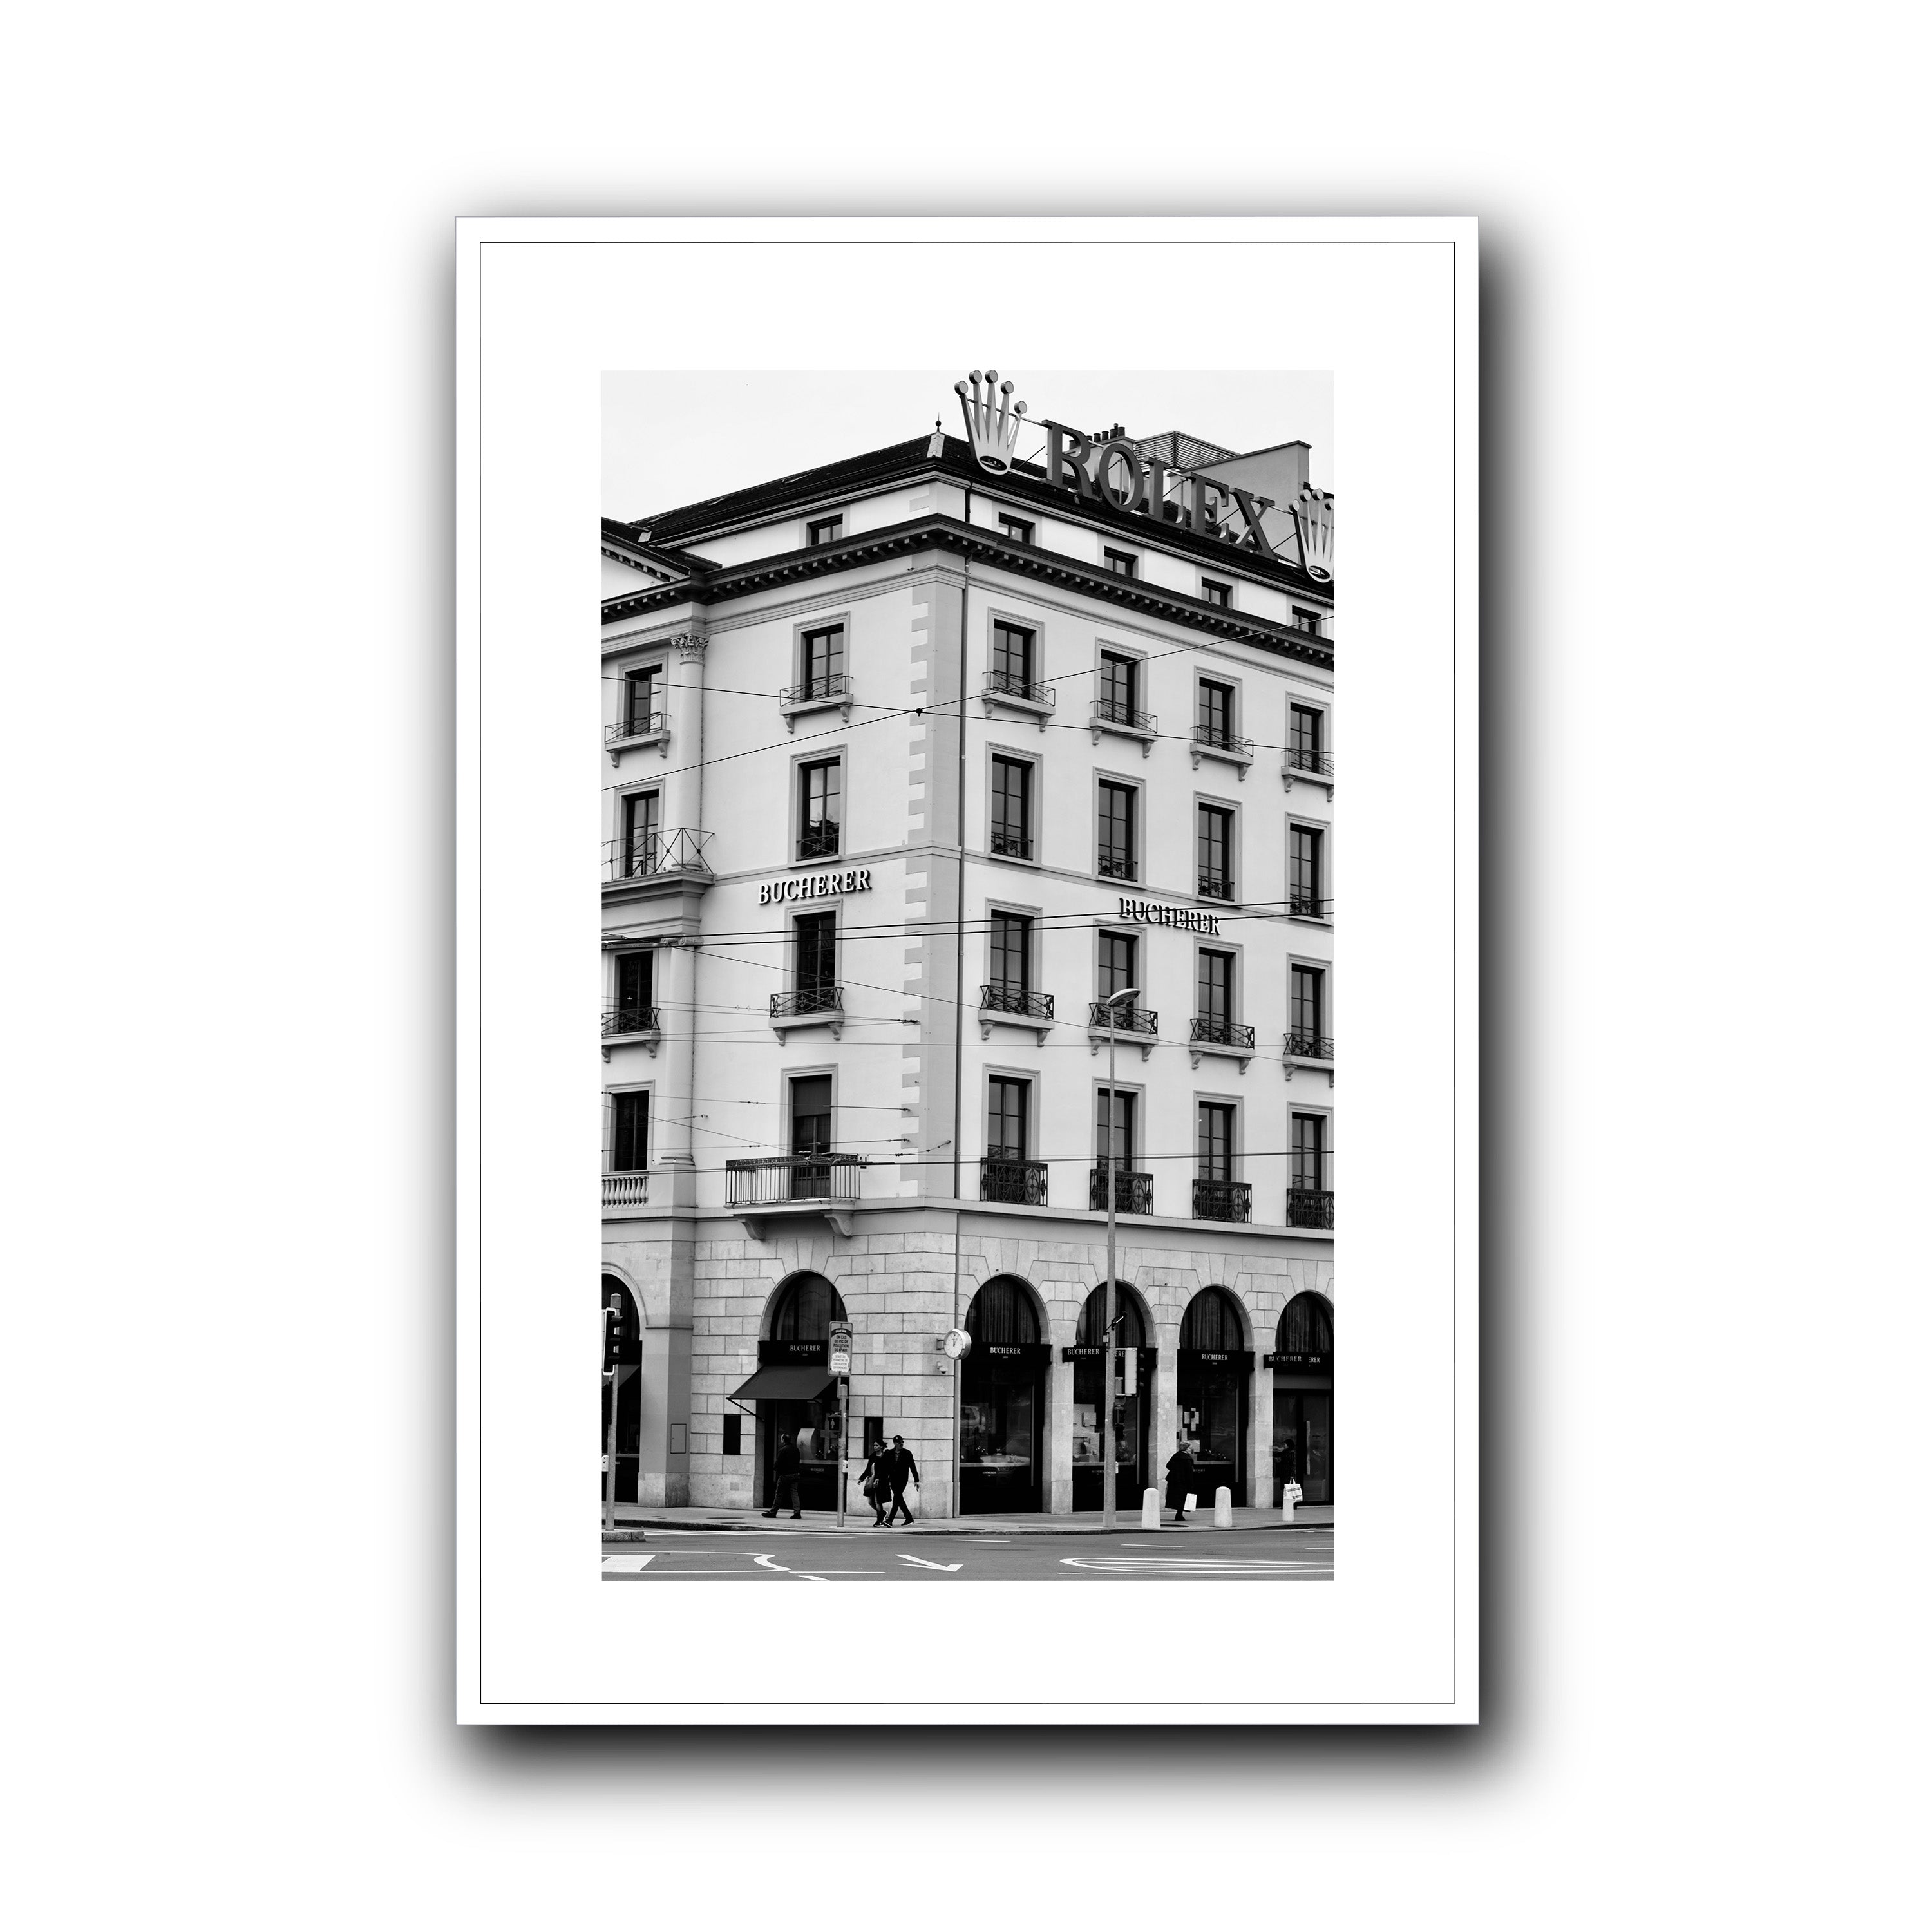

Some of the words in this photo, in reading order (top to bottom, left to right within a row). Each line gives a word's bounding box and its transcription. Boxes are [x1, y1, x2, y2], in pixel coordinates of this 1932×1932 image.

[1042, 419, 1279, 561] ROLEX
[758, 869, 871, 904] BUCHERER
[1119, 897, 1221, 935] BUCHERER
